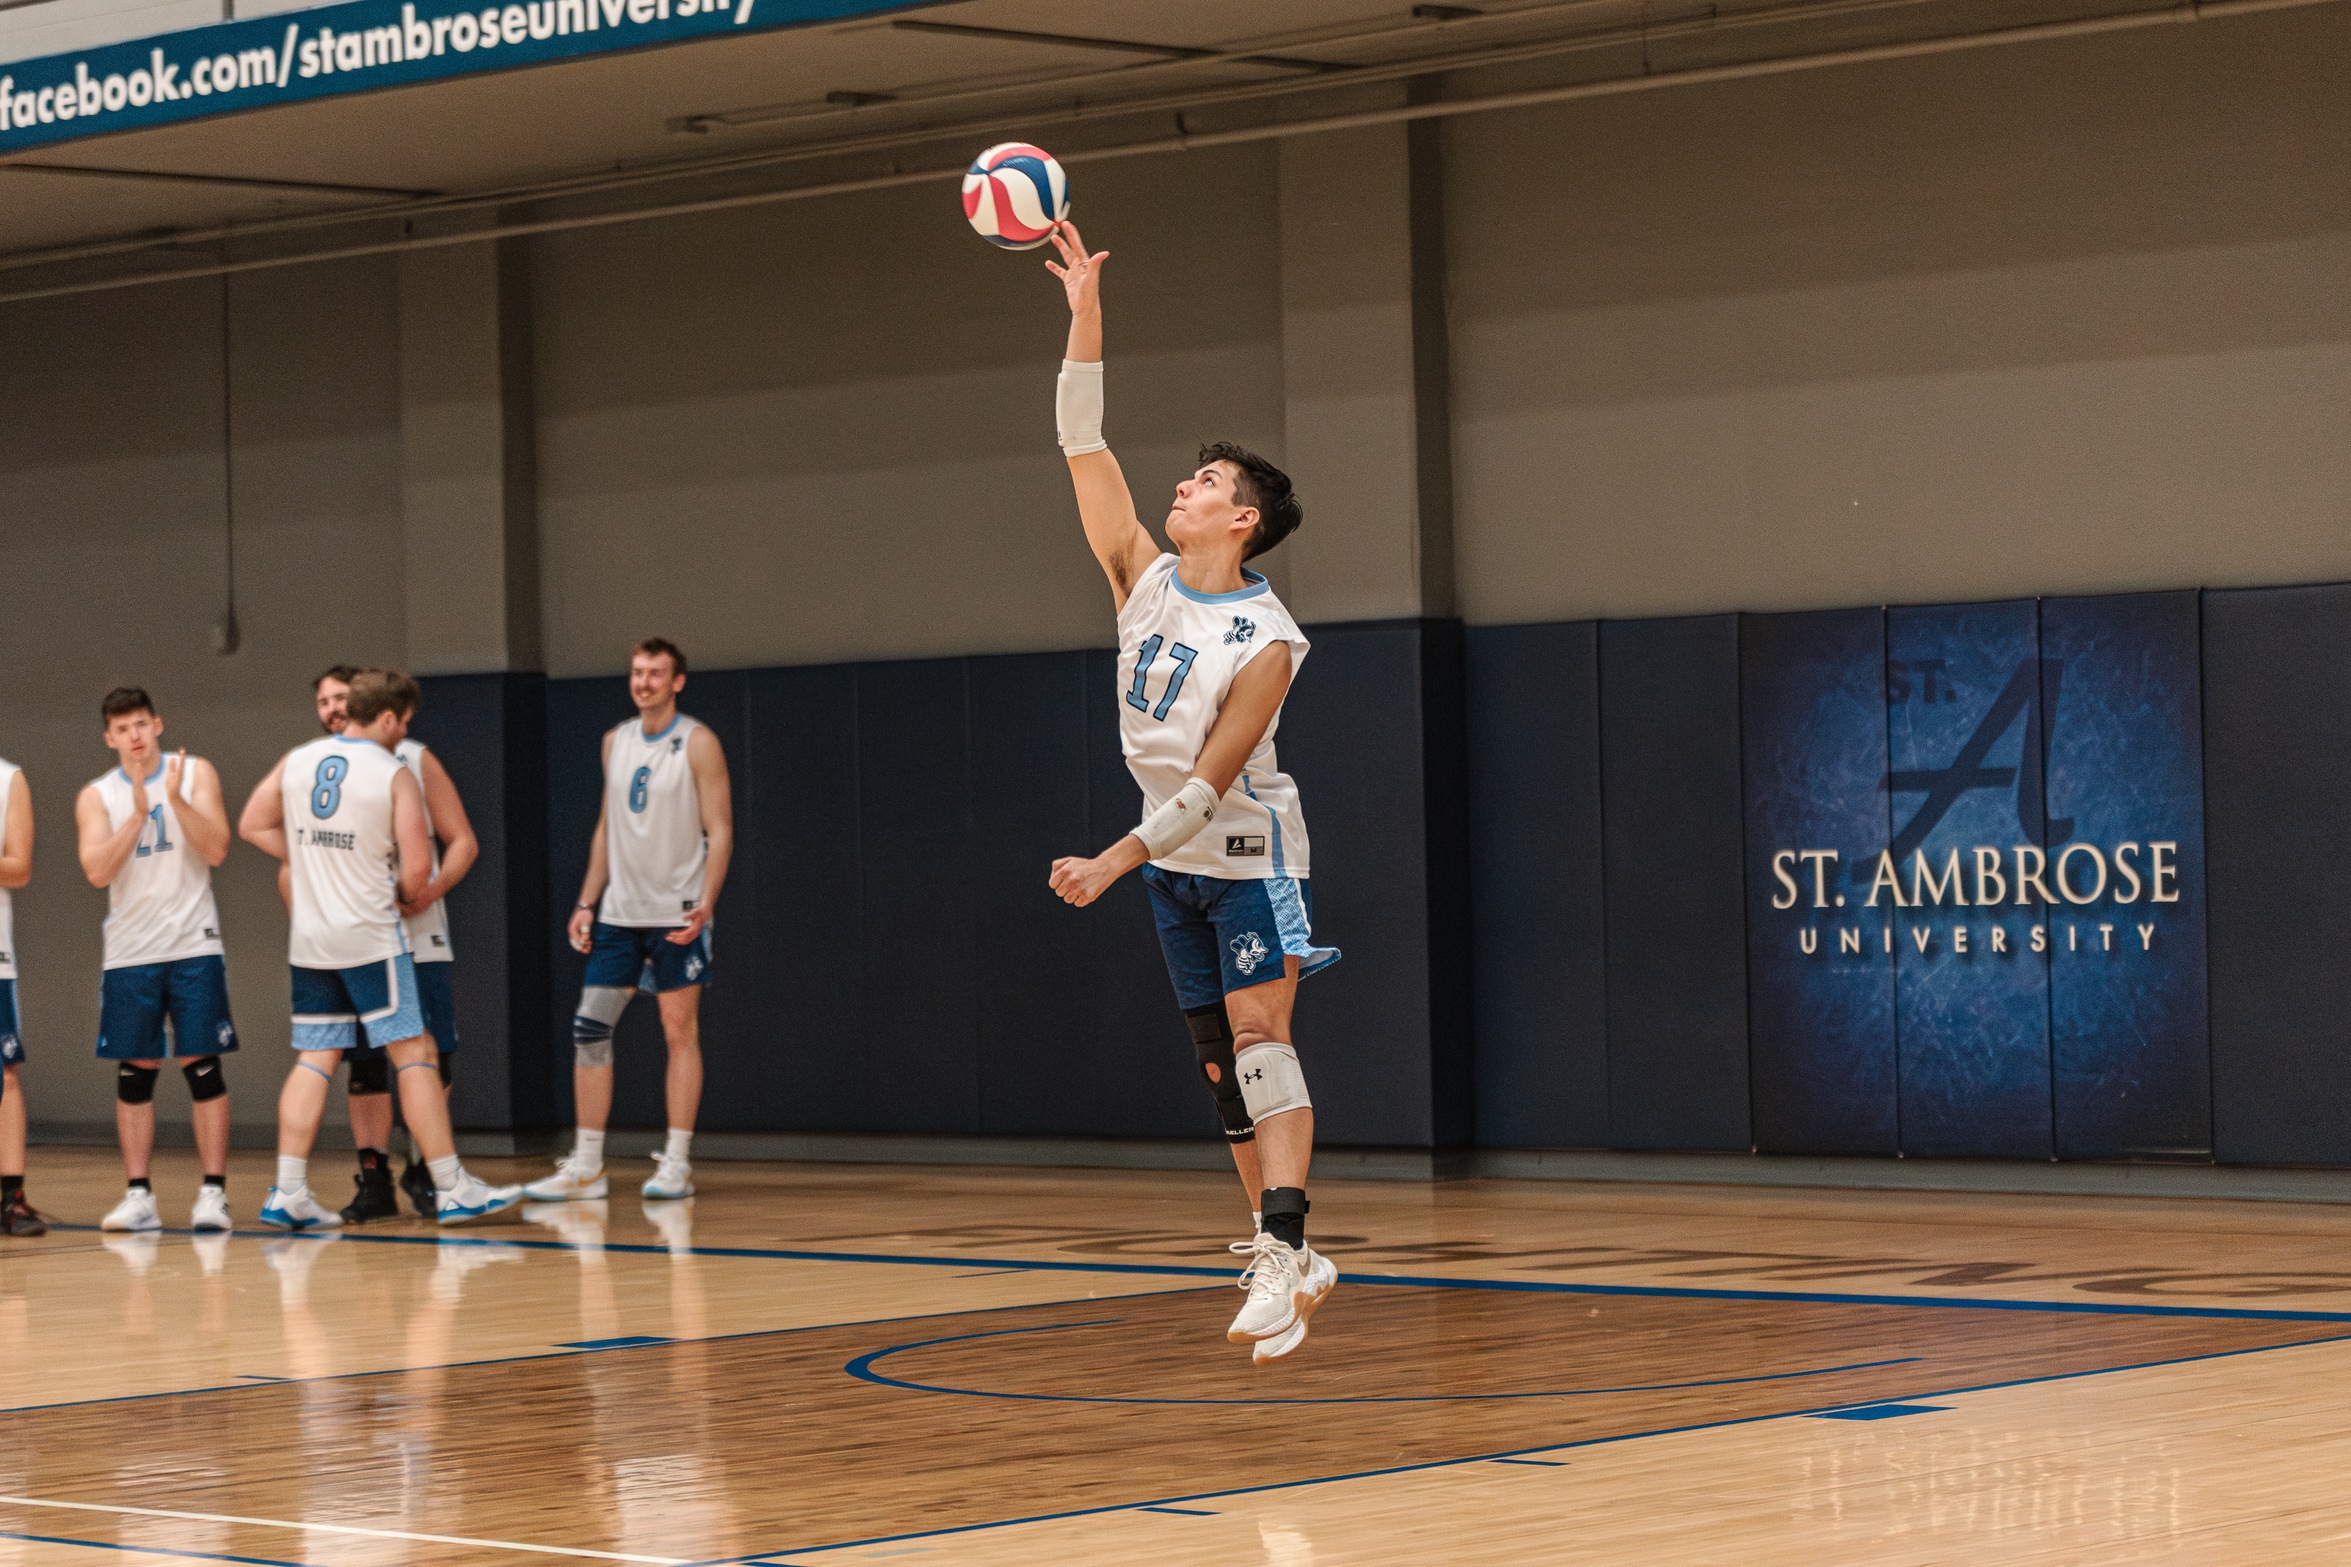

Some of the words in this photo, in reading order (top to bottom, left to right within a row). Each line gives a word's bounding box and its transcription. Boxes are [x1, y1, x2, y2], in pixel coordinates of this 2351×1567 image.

[1126, 634, 1198, 722] 17
[311, 755, 348, 820] 8
[629, 766, 651, 814] 6
[1772, 849, 1845, 909] ST.
[1863, 841, 2180, 907] AMBROSE
[1800, 924, 2155, 954] UNIVERSITY
